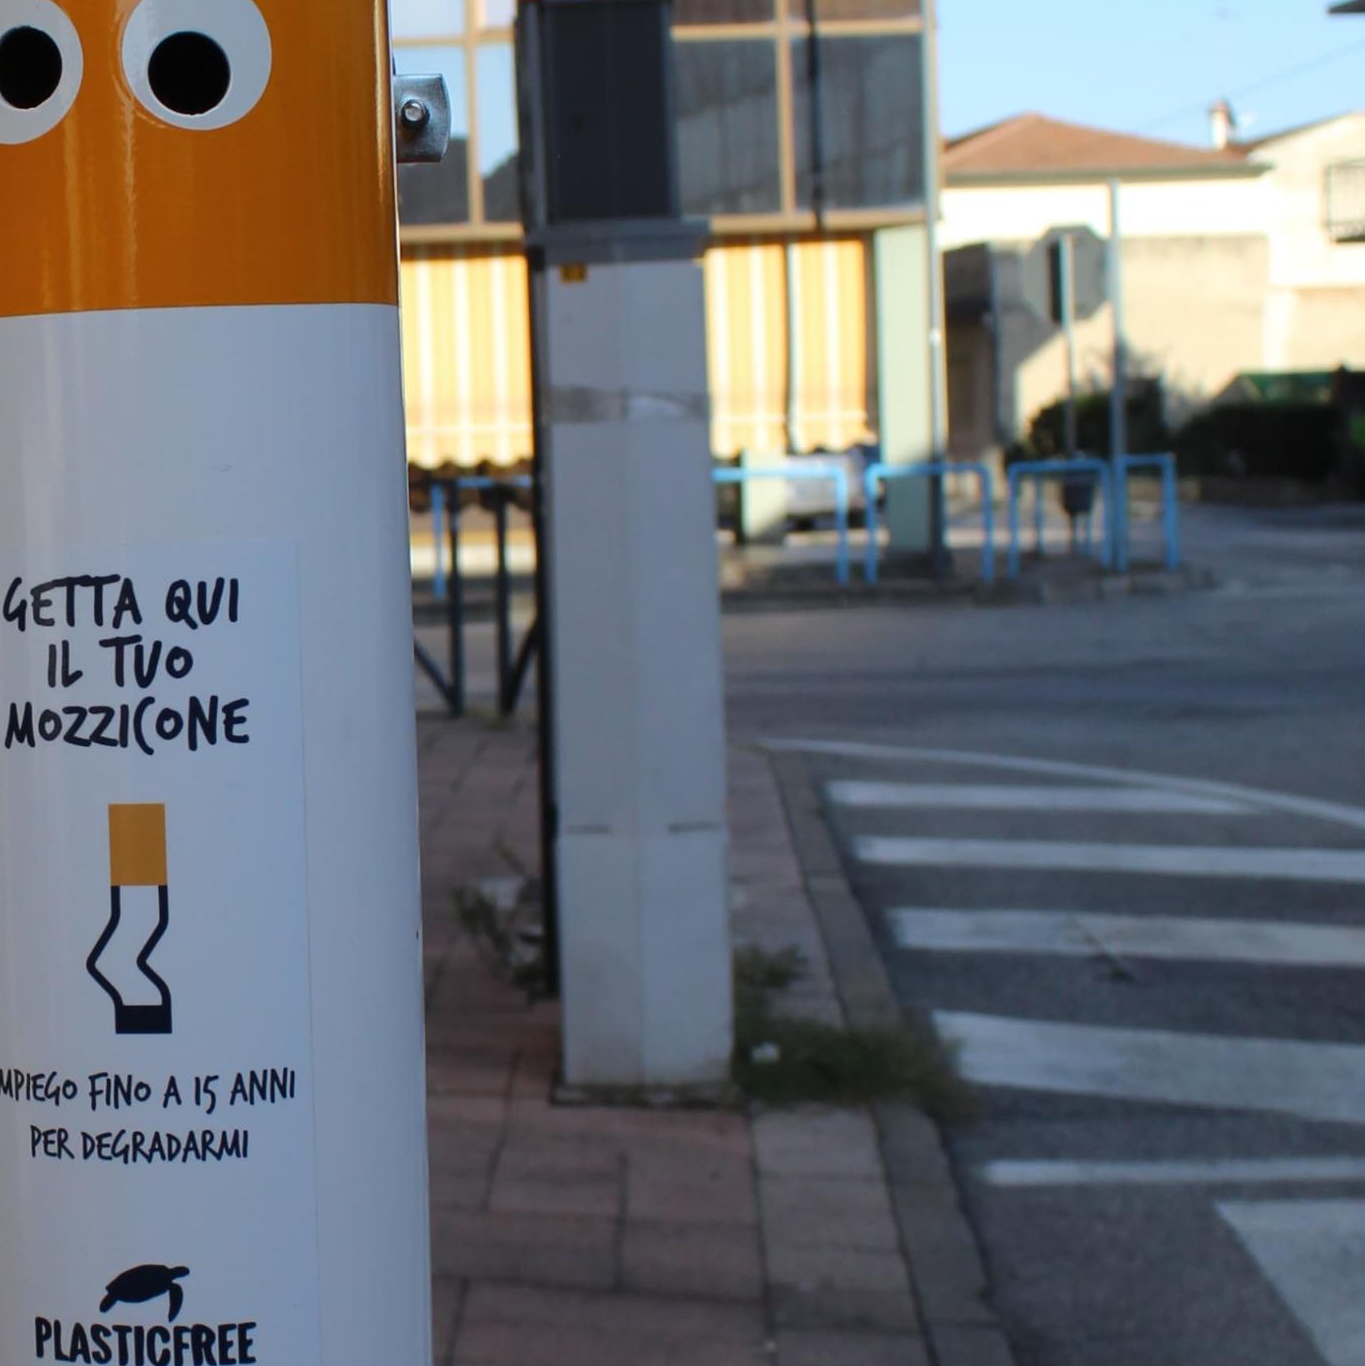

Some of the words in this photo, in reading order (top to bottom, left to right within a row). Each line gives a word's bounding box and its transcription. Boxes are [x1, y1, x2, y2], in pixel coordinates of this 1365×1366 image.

[3, 574, 142, 632] GETTA
[165, 577, 239, 630] QUI
[48, 640, 83, 688] IL
[99, 634, 193, 689] TUO
[5, 695, 250, 755] MOZZICONE
[88, 1071, 152, 1111] FINO
[163, 1075, 182, 1109] A
[194, 1075, 219, 1115] 15
[229, 1067, 296, 1106] ANNI
[30, 1124, 75, 1160] PER
[81, 1128, 249, 1164] DEGRADARMI
